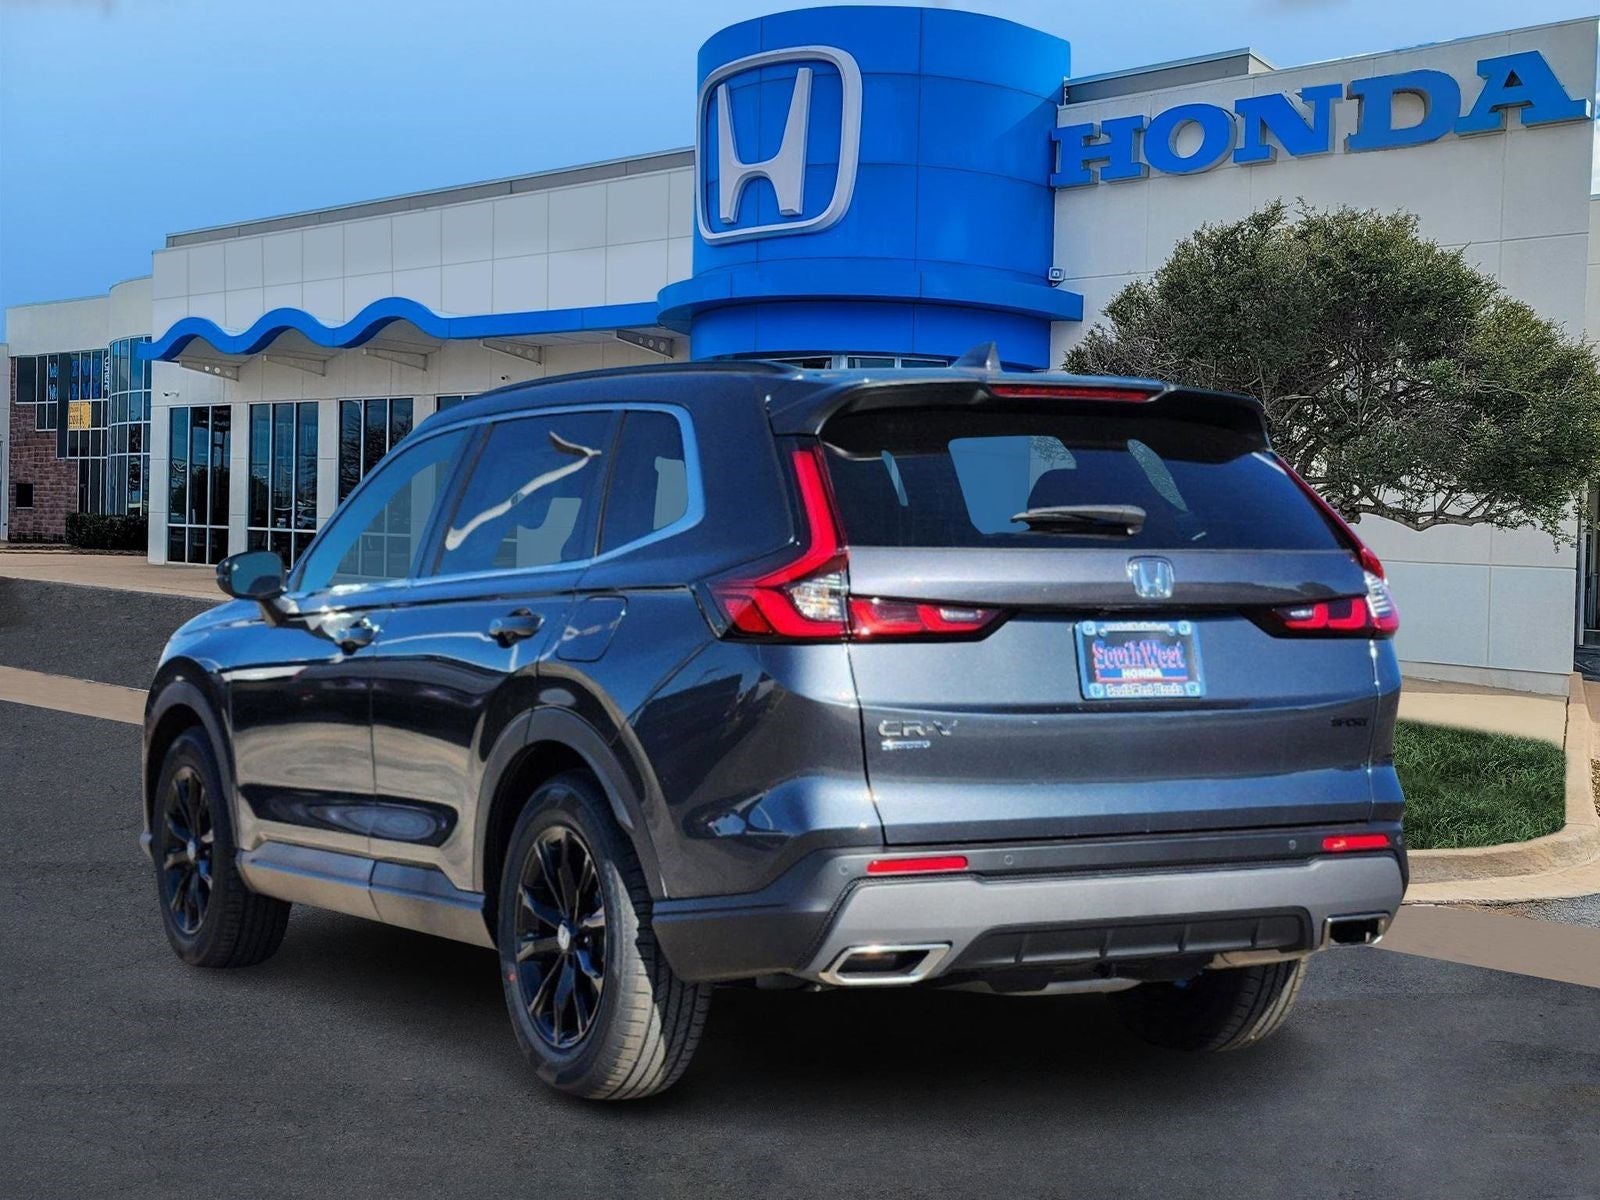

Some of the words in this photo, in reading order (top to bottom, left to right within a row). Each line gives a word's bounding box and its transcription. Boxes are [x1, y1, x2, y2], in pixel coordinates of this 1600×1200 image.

[1051, 50, 1592, 189] HONDA
[1121, 668, 1163, 679] HONDA
[878, 720, 959, 737] CR-V
